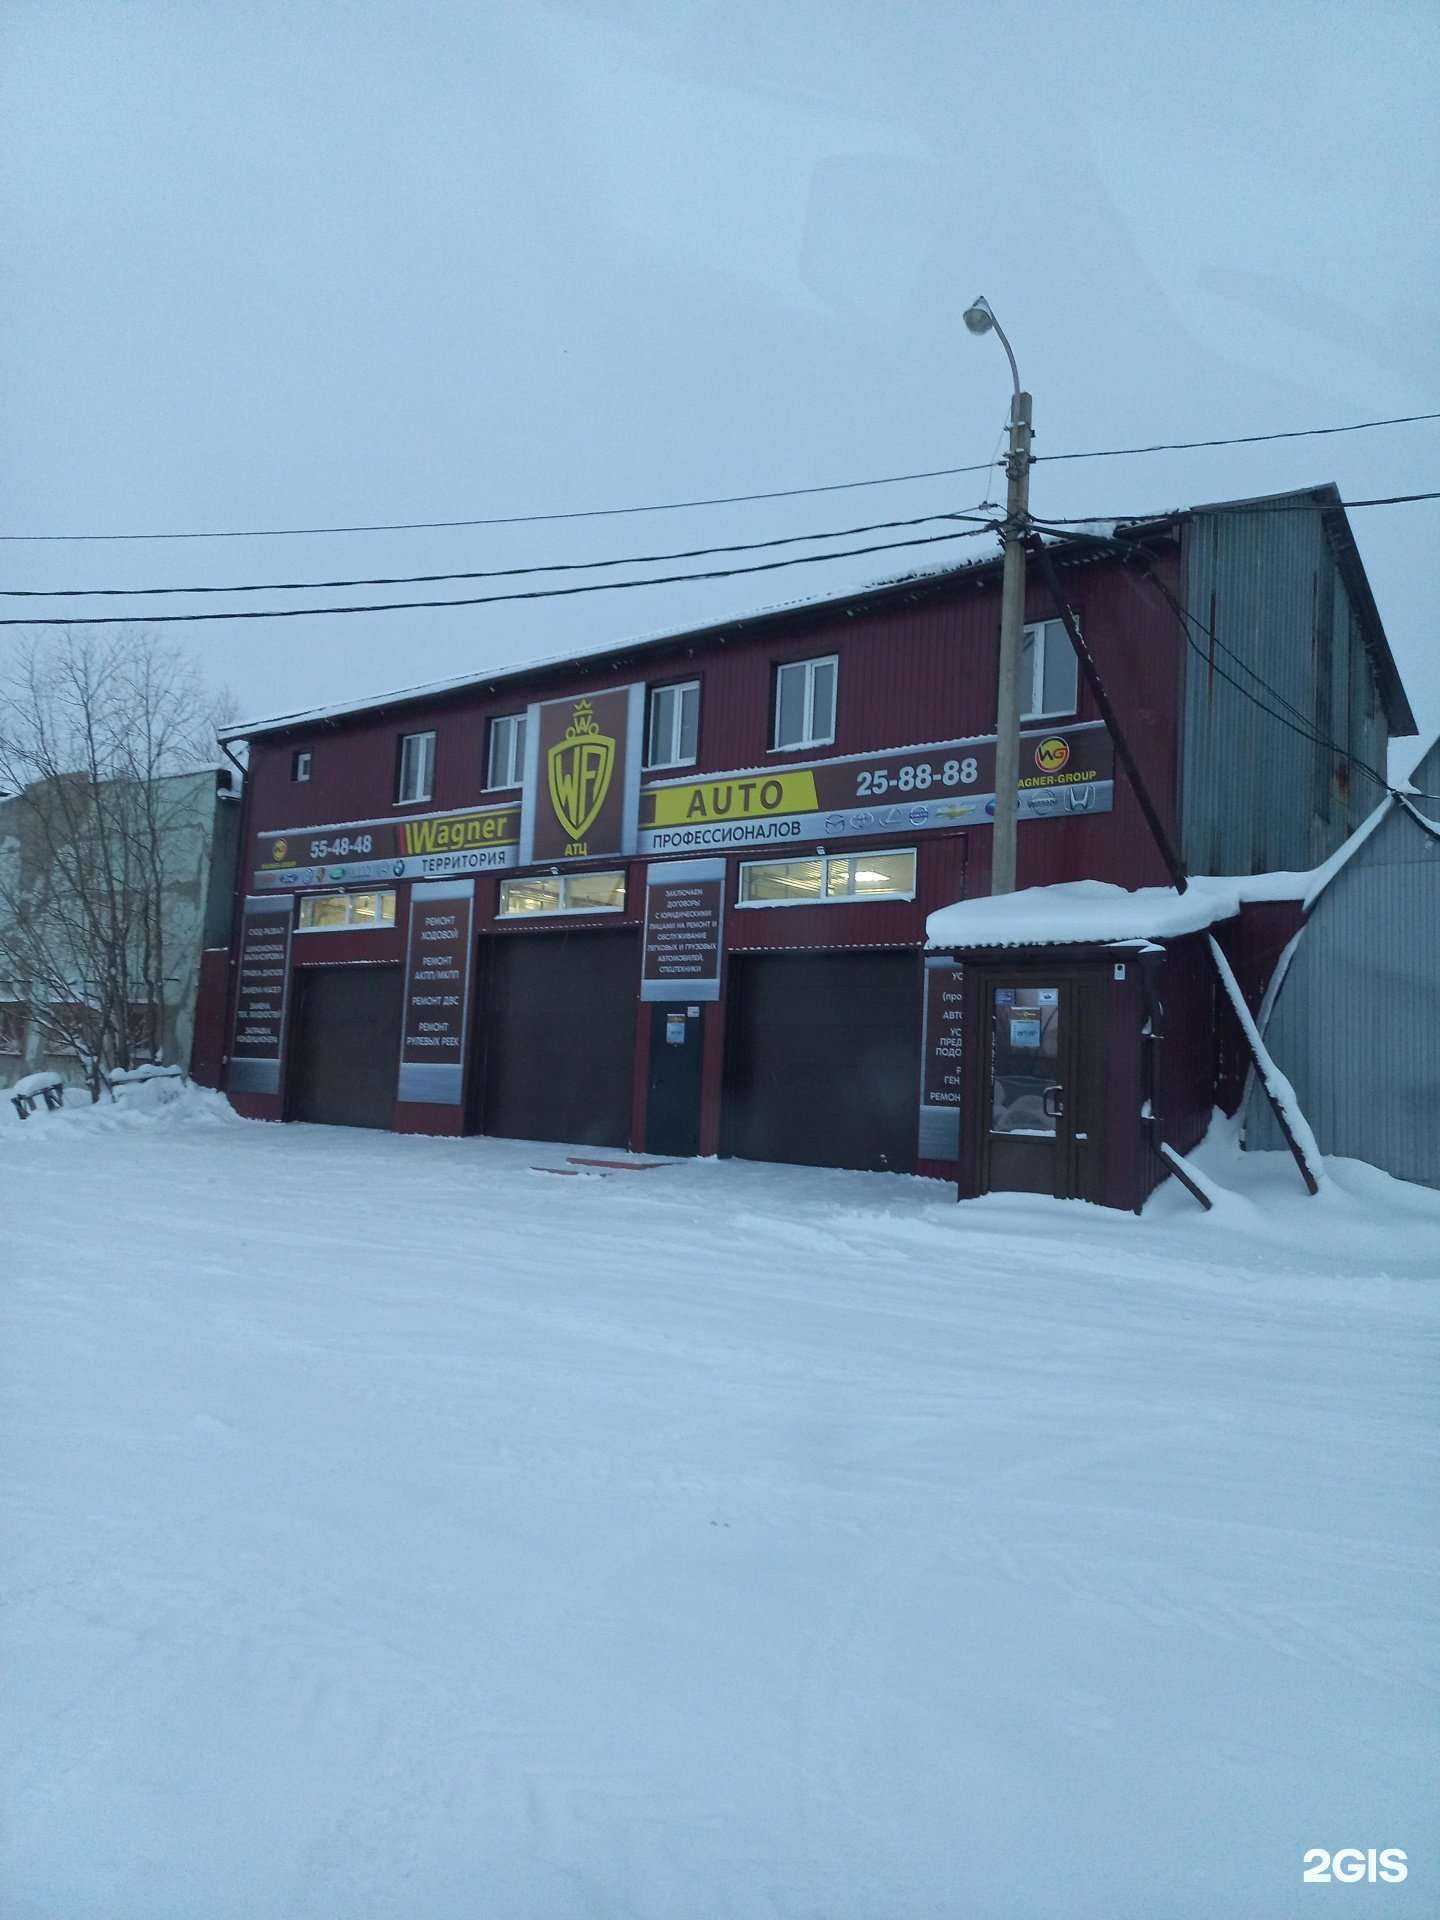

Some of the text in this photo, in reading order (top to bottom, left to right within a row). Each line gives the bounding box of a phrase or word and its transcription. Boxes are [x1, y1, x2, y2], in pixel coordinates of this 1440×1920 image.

[856, 757, 978, 797] 25-88-88
[1018, 770, 1097, 789] AGNER-GROUP
[686, 780, 783, 818] AUTO
[411, 815, 508, 855] Wagner
[653, 821, 801, 849] ПРОФЕССИОНАЛОВ
[309, 834, 373, 859] 55-48-48
[564, 842, 588, 857] АТЦ
[422, 851, 506, 873] ТЕРРИТОРИЯ
[424, 916, 456, 926] РЕМОНТ
[421, 928, 459, 941] ХОДОВОЙ
[423, 956, 453, 966] РЕМОНТ
[952, 972, 963, 981] УС
[412, 997, 442, 1006] РЕМОНТ
[943, 992, 962, 1001] (про
[418, 1022, 449, 1032] РЕМОНТ
[950, 1028, 961, 1036] УС
[940, 1038, 962, 1047] ПРЕД
[936, 1048, 961, 1057] ПОДО
[944, 1076, 960, 1085] ГЕН
[930, 1092, 960, 1101] РЕМОН
